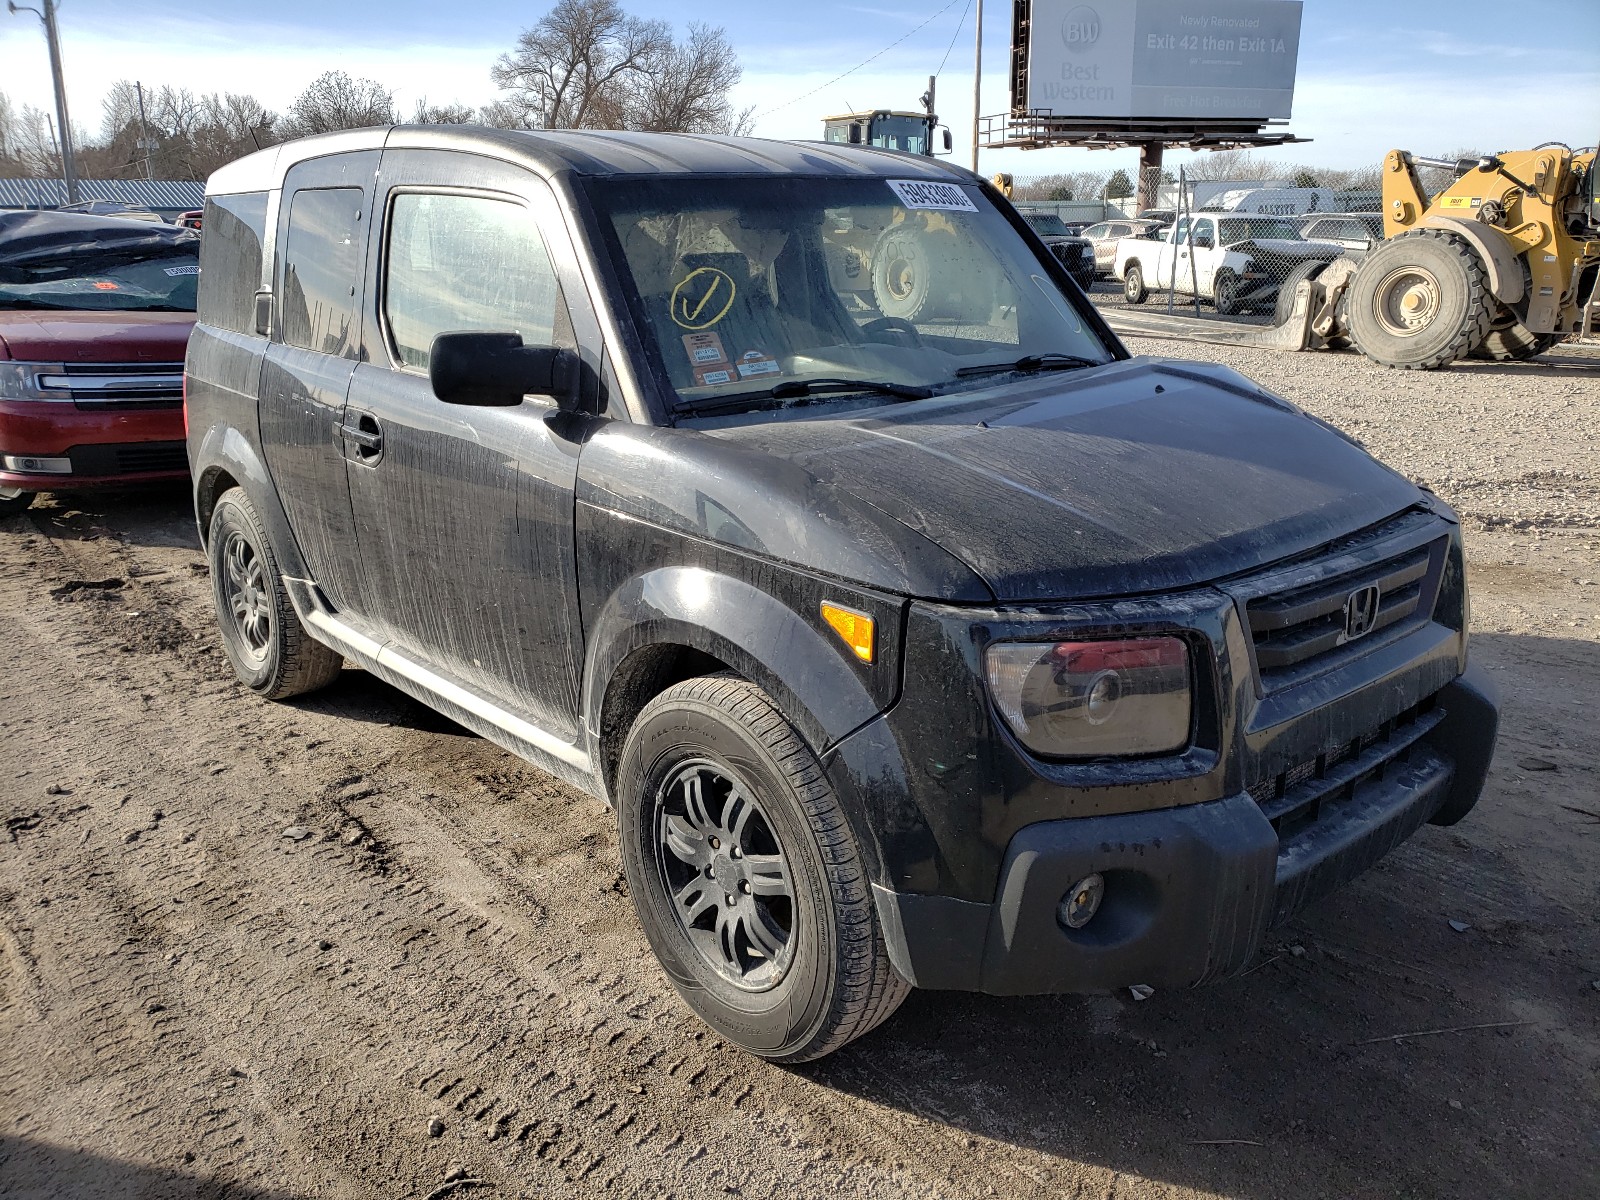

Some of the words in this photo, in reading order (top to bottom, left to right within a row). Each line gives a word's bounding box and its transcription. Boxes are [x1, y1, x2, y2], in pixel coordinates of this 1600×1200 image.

[1179, 15, 1209, 28] Newly
[1210, 15, 1260, 28] Renovated
[1066, 22, 1100, 43] BW
[1146, 33, 1176, 49] Exit
[1179, 35, 1199, 50] 42
[1202, 35, 1235, 51] then
[1238, 37, 1267, 52] Exit
[1270, 38, 1286, 53] 1A
[1061, 61, 1101, 81] Best
[1042, 81, 1115, 101] Western
[1189, 95, 1211, 107] Hot
[898, 183, 966, 206] 59433900
